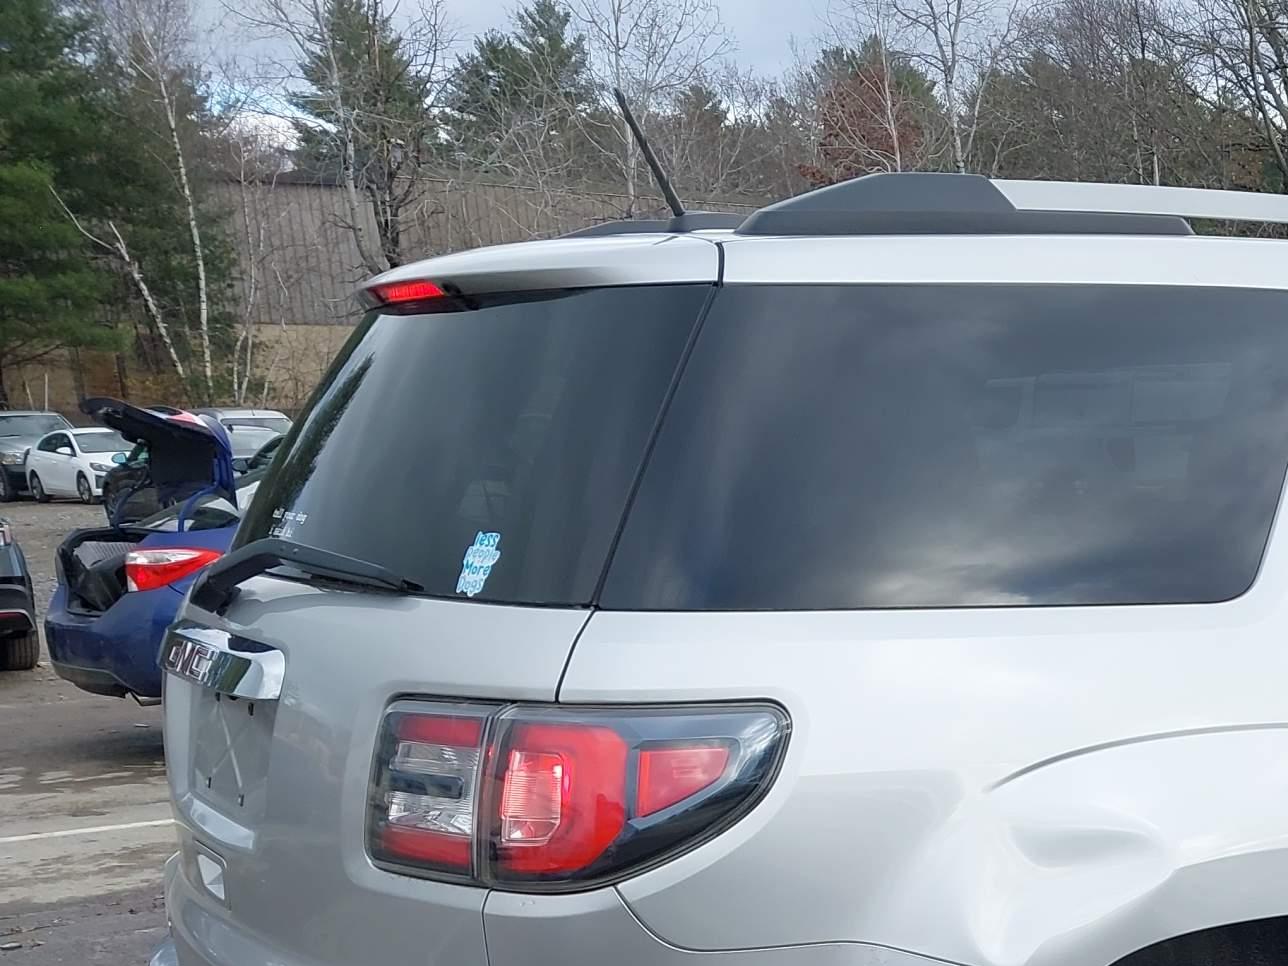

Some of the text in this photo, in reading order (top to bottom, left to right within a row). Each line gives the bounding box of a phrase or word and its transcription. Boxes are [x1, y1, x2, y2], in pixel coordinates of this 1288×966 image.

[463, 560, 491, 577] More
[458, 576, 484, 593] Dogs
[166, 640, 218, 682] GMC
